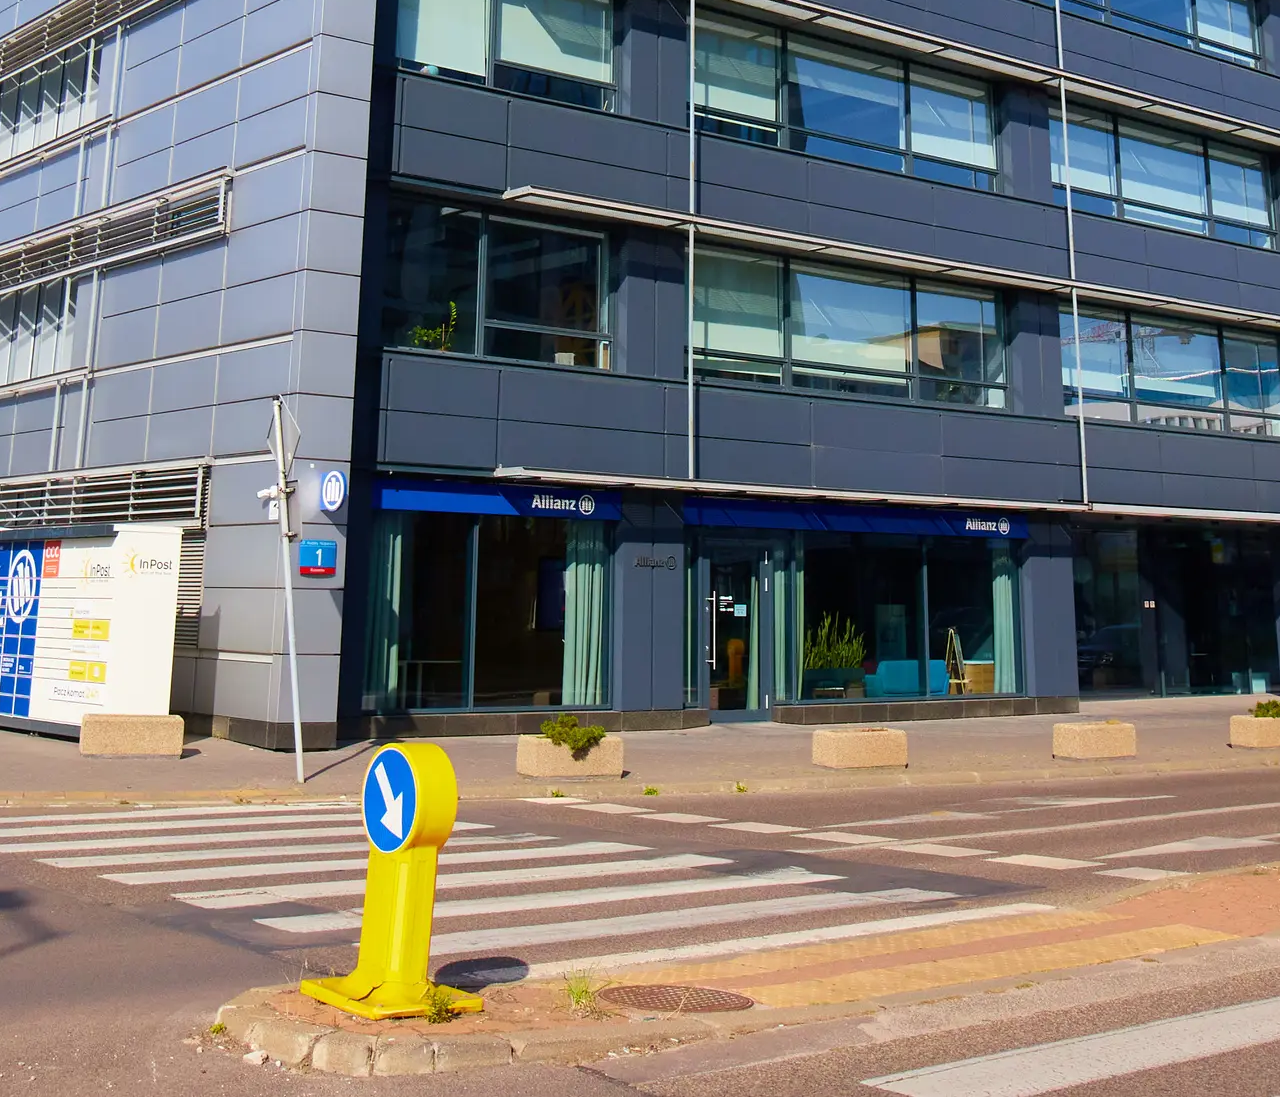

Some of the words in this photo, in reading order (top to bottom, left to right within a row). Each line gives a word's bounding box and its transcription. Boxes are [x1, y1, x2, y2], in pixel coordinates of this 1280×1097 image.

[532, 494, 577, 510] Allianz
[965, 518, 997, 531] Allianz
[316, 548, 322, 566] 1
[634, 556, 665, 568] Allianz
